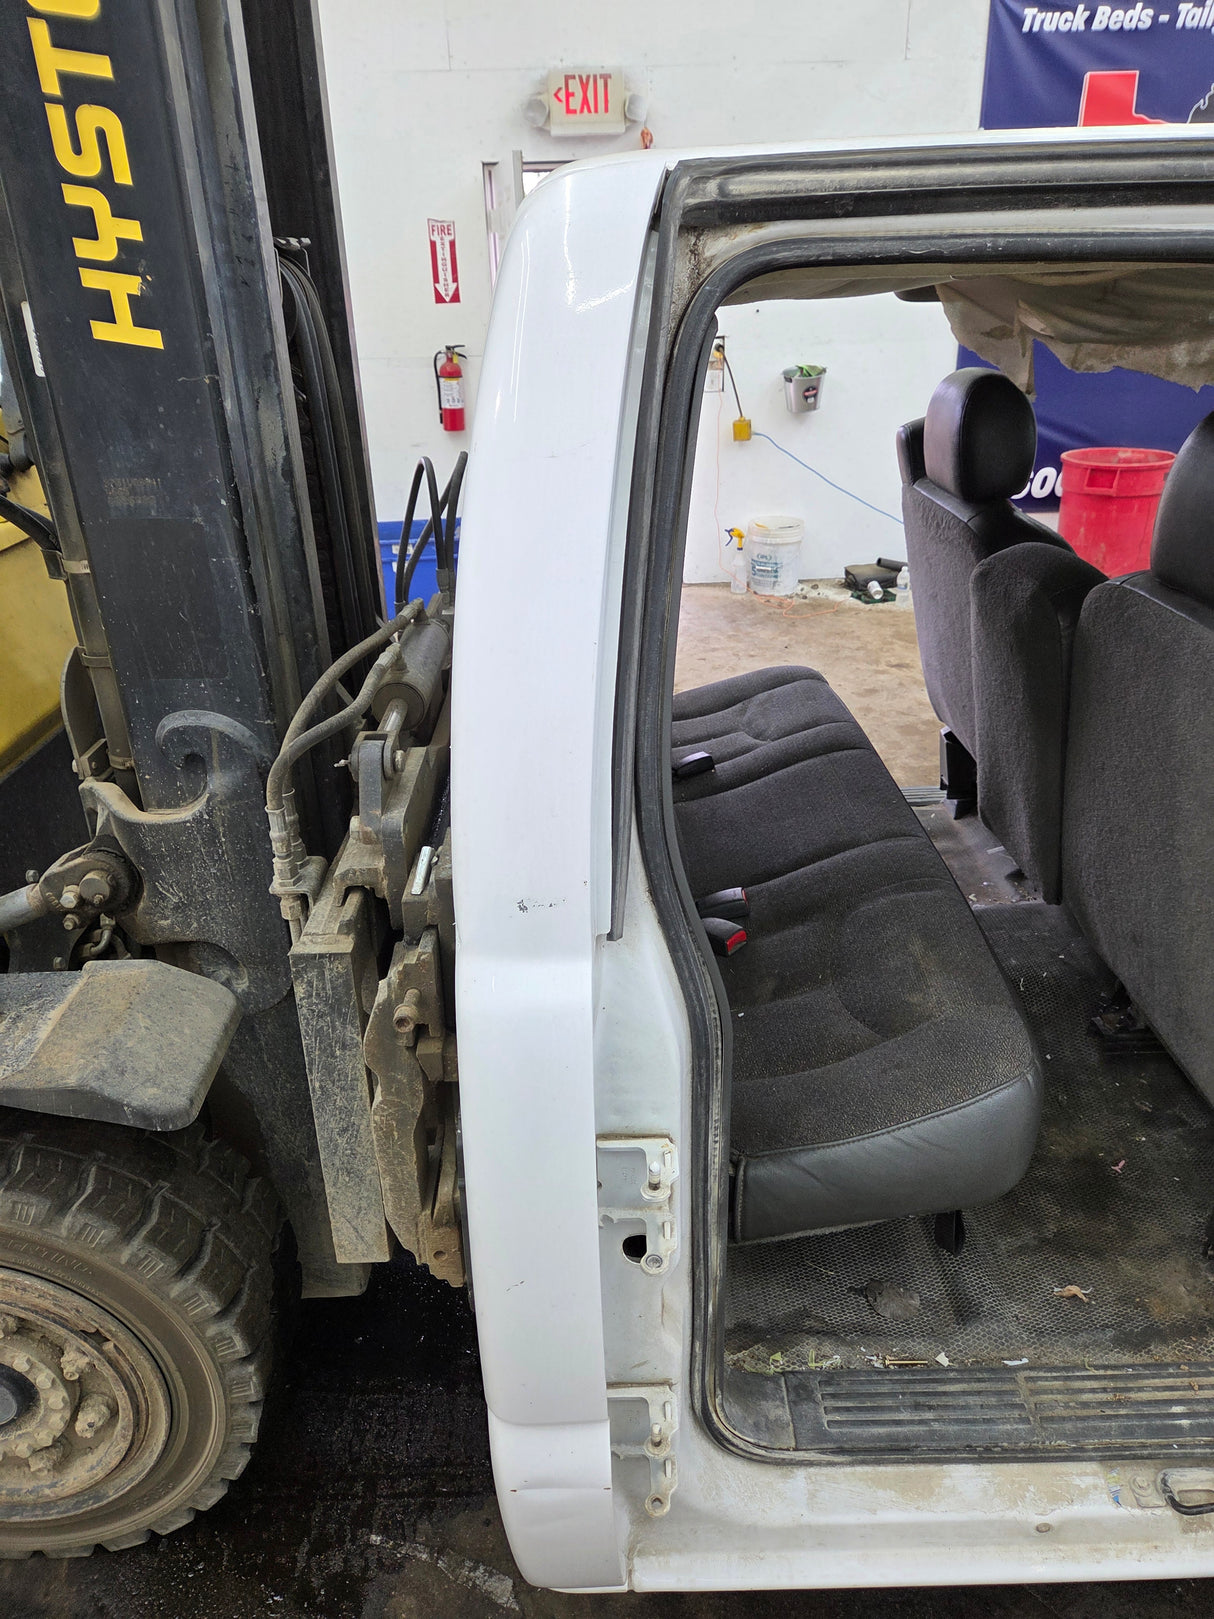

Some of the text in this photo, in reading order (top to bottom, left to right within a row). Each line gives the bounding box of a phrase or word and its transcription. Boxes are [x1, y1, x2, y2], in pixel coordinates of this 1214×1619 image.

[1022, 4, 1090, 33] Truck
[1091, 2, 1154, 31] Beds
[1175, 0, 1214, 35] Tail
[564, 73, 612, 115] EXIT
[431, 224, 452, 236] FIRE
